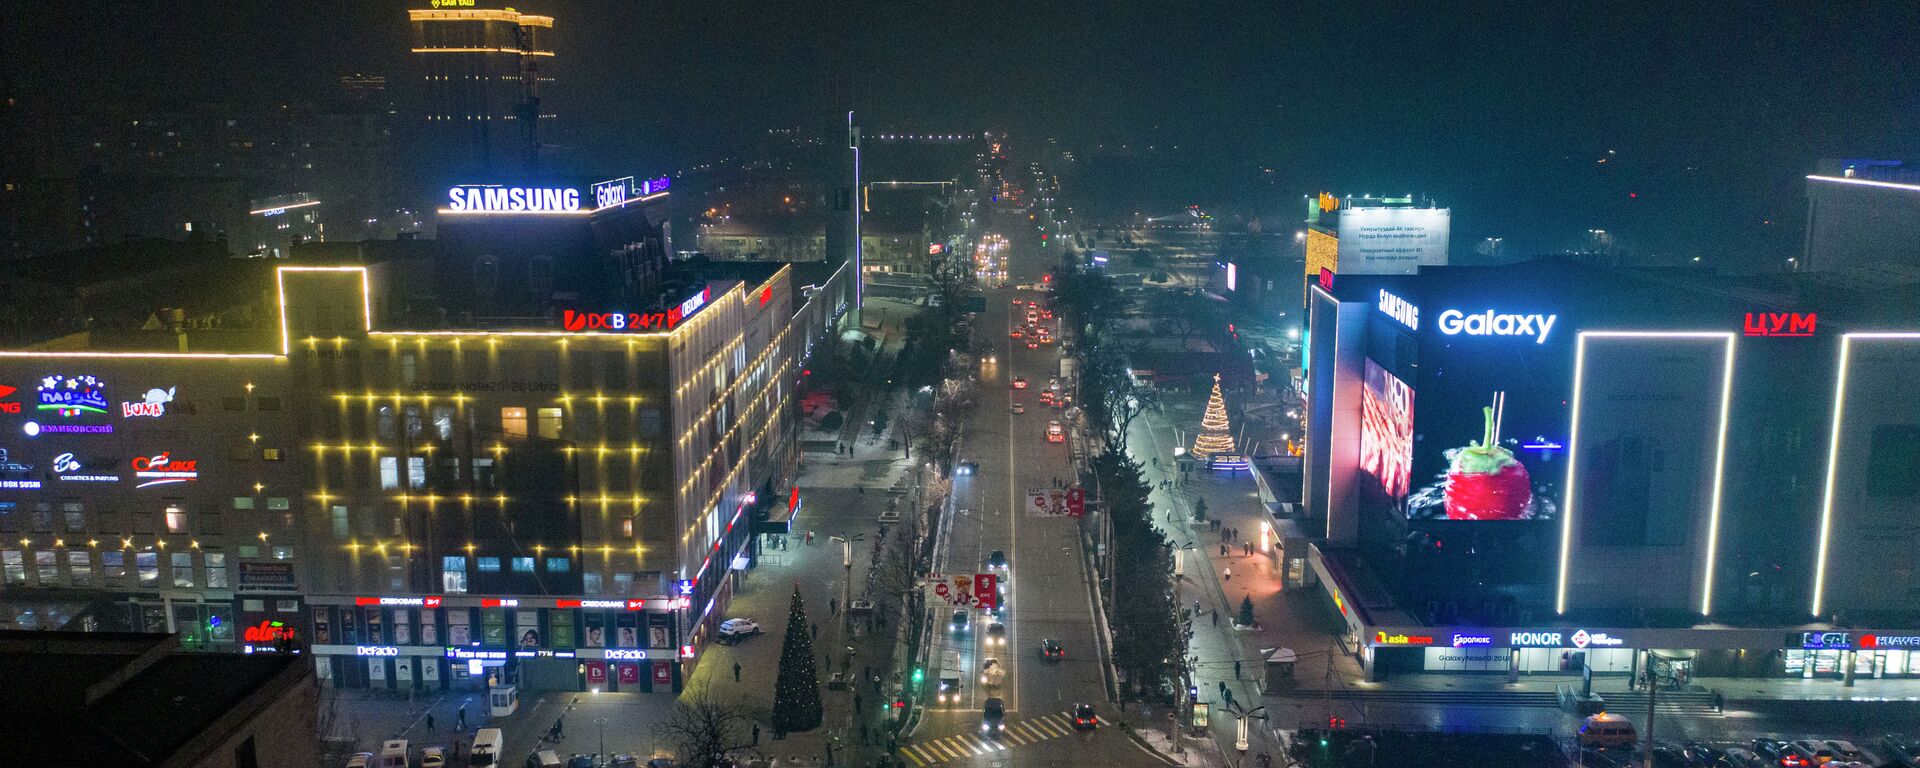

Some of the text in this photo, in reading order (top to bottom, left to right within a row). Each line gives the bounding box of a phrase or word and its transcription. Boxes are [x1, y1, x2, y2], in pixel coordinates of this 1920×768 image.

[450, 187, 580, 211] SAMSUNG
[597, 182, 626, 208] Galaxy
[1379, 288, 1419, 331] SAMSUNG
[588, 313, 625, 329] DCB
[1438, 309, 1556, 344] Galaxy
[1744, 313, 1817, 336] ЦУМ
[122, 402, 162, 417] LUNA
[41, 424, 113, 433] КУЛИКОВСКИЙ
[1511, 632, 1561, 645] HONOR
[357, 646, 398, 655] DeFacto
[605, 649, 646, 659] DeFacto
[1439, 655, 1466, 663] Galaxy
